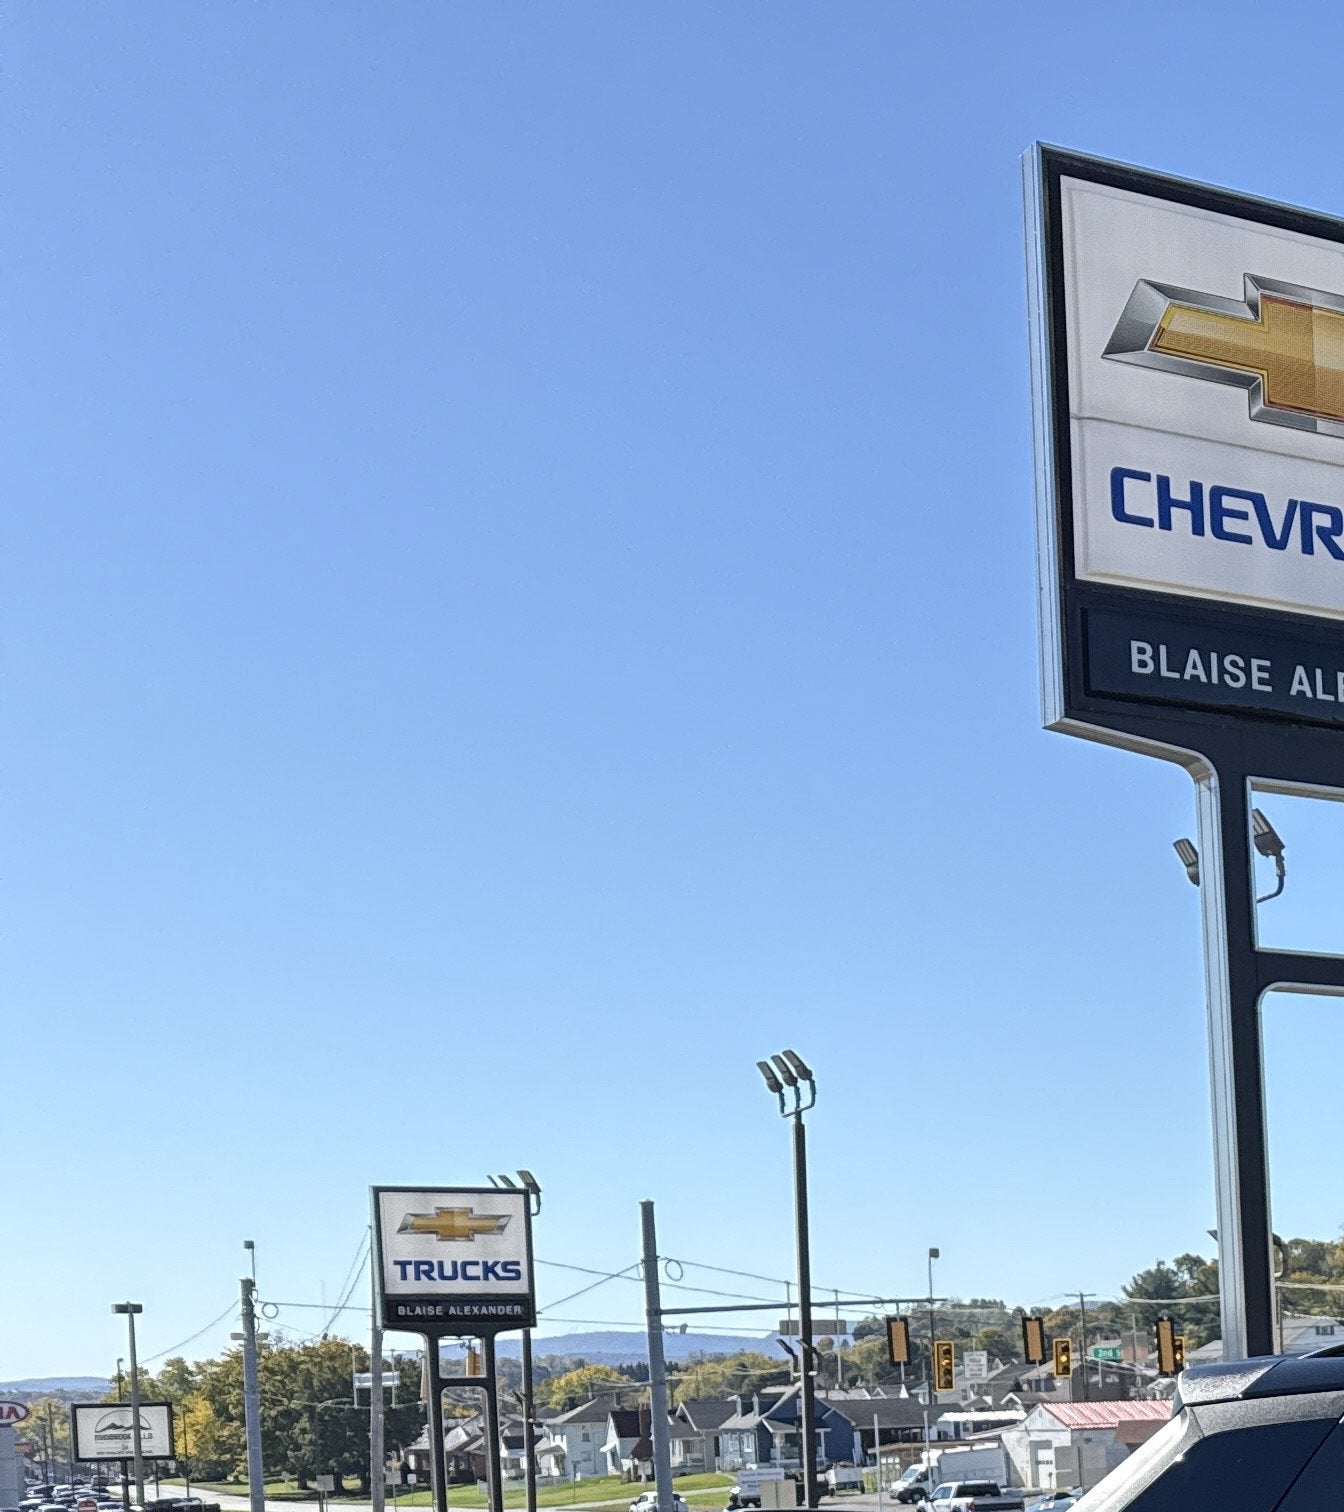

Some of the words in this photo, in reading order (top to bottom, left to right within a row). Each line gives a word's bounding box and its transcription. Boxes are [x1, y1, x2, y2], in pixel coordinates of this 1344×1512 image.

[1130, 640, 1273, 693] BLAISE
[393, 1260, 522, 1281] TRUCKS
[397, 1305, 444, 1316] BLAISE
[448, 1305, 522, 1316] ALEXANDER
